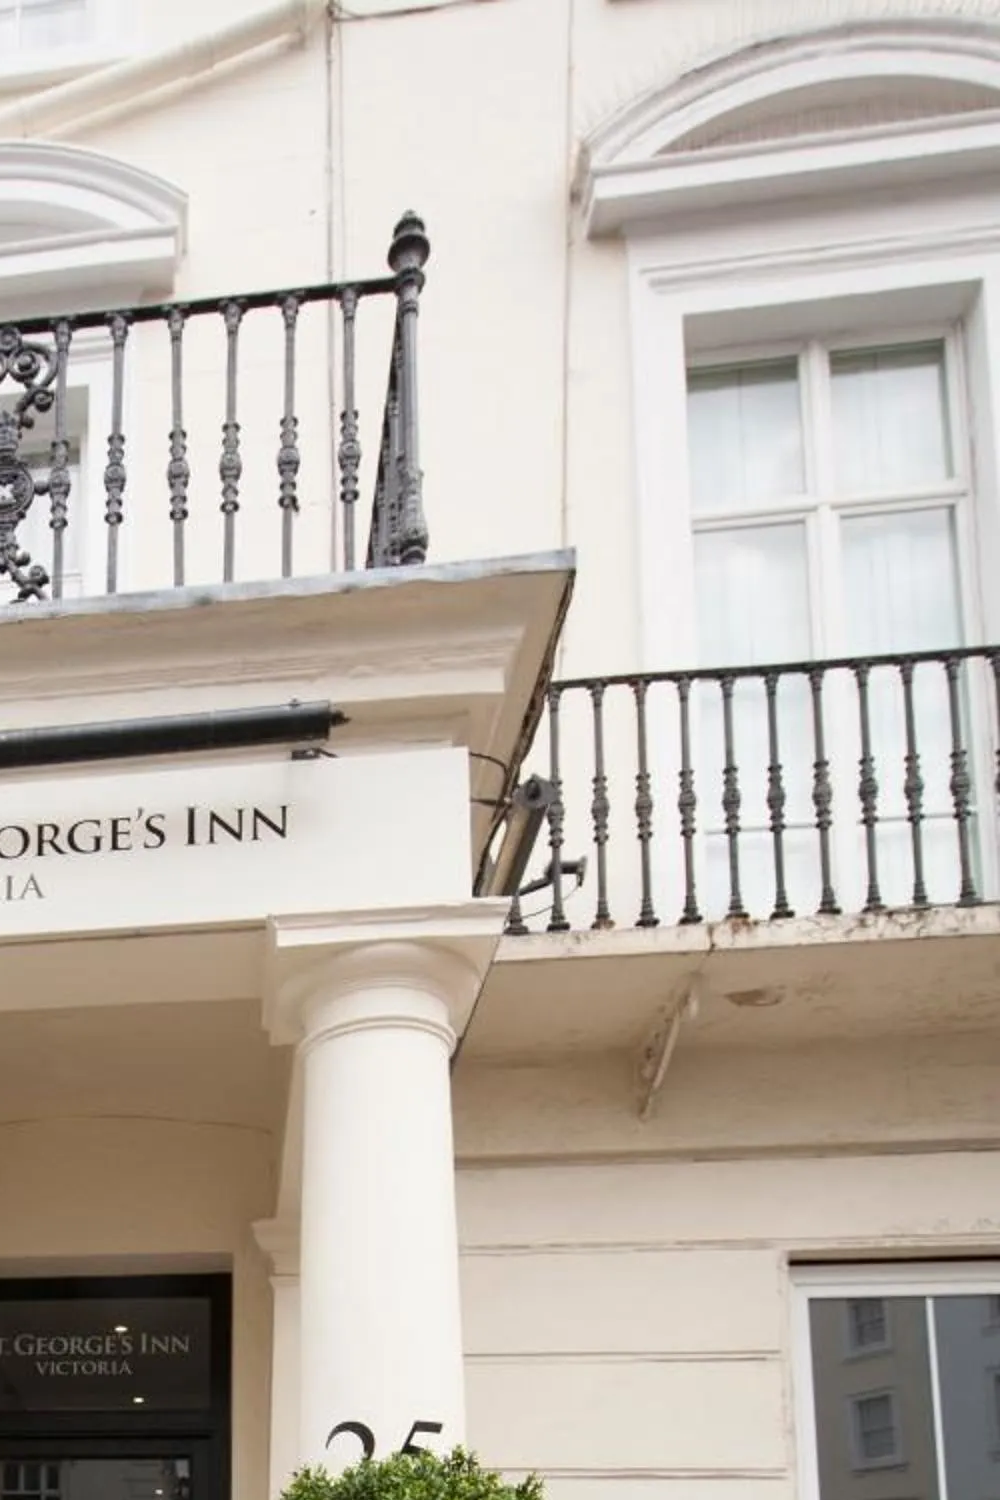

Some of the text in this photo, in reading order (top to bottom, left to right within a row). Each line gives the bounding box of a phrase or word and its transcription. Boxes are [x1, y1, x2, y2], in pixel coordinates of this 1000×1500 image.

[185, 805, 288, 846] INN
[141, 1332, 190, 1353] INN
[35, 1360, 133, 1376] VICTORIA
